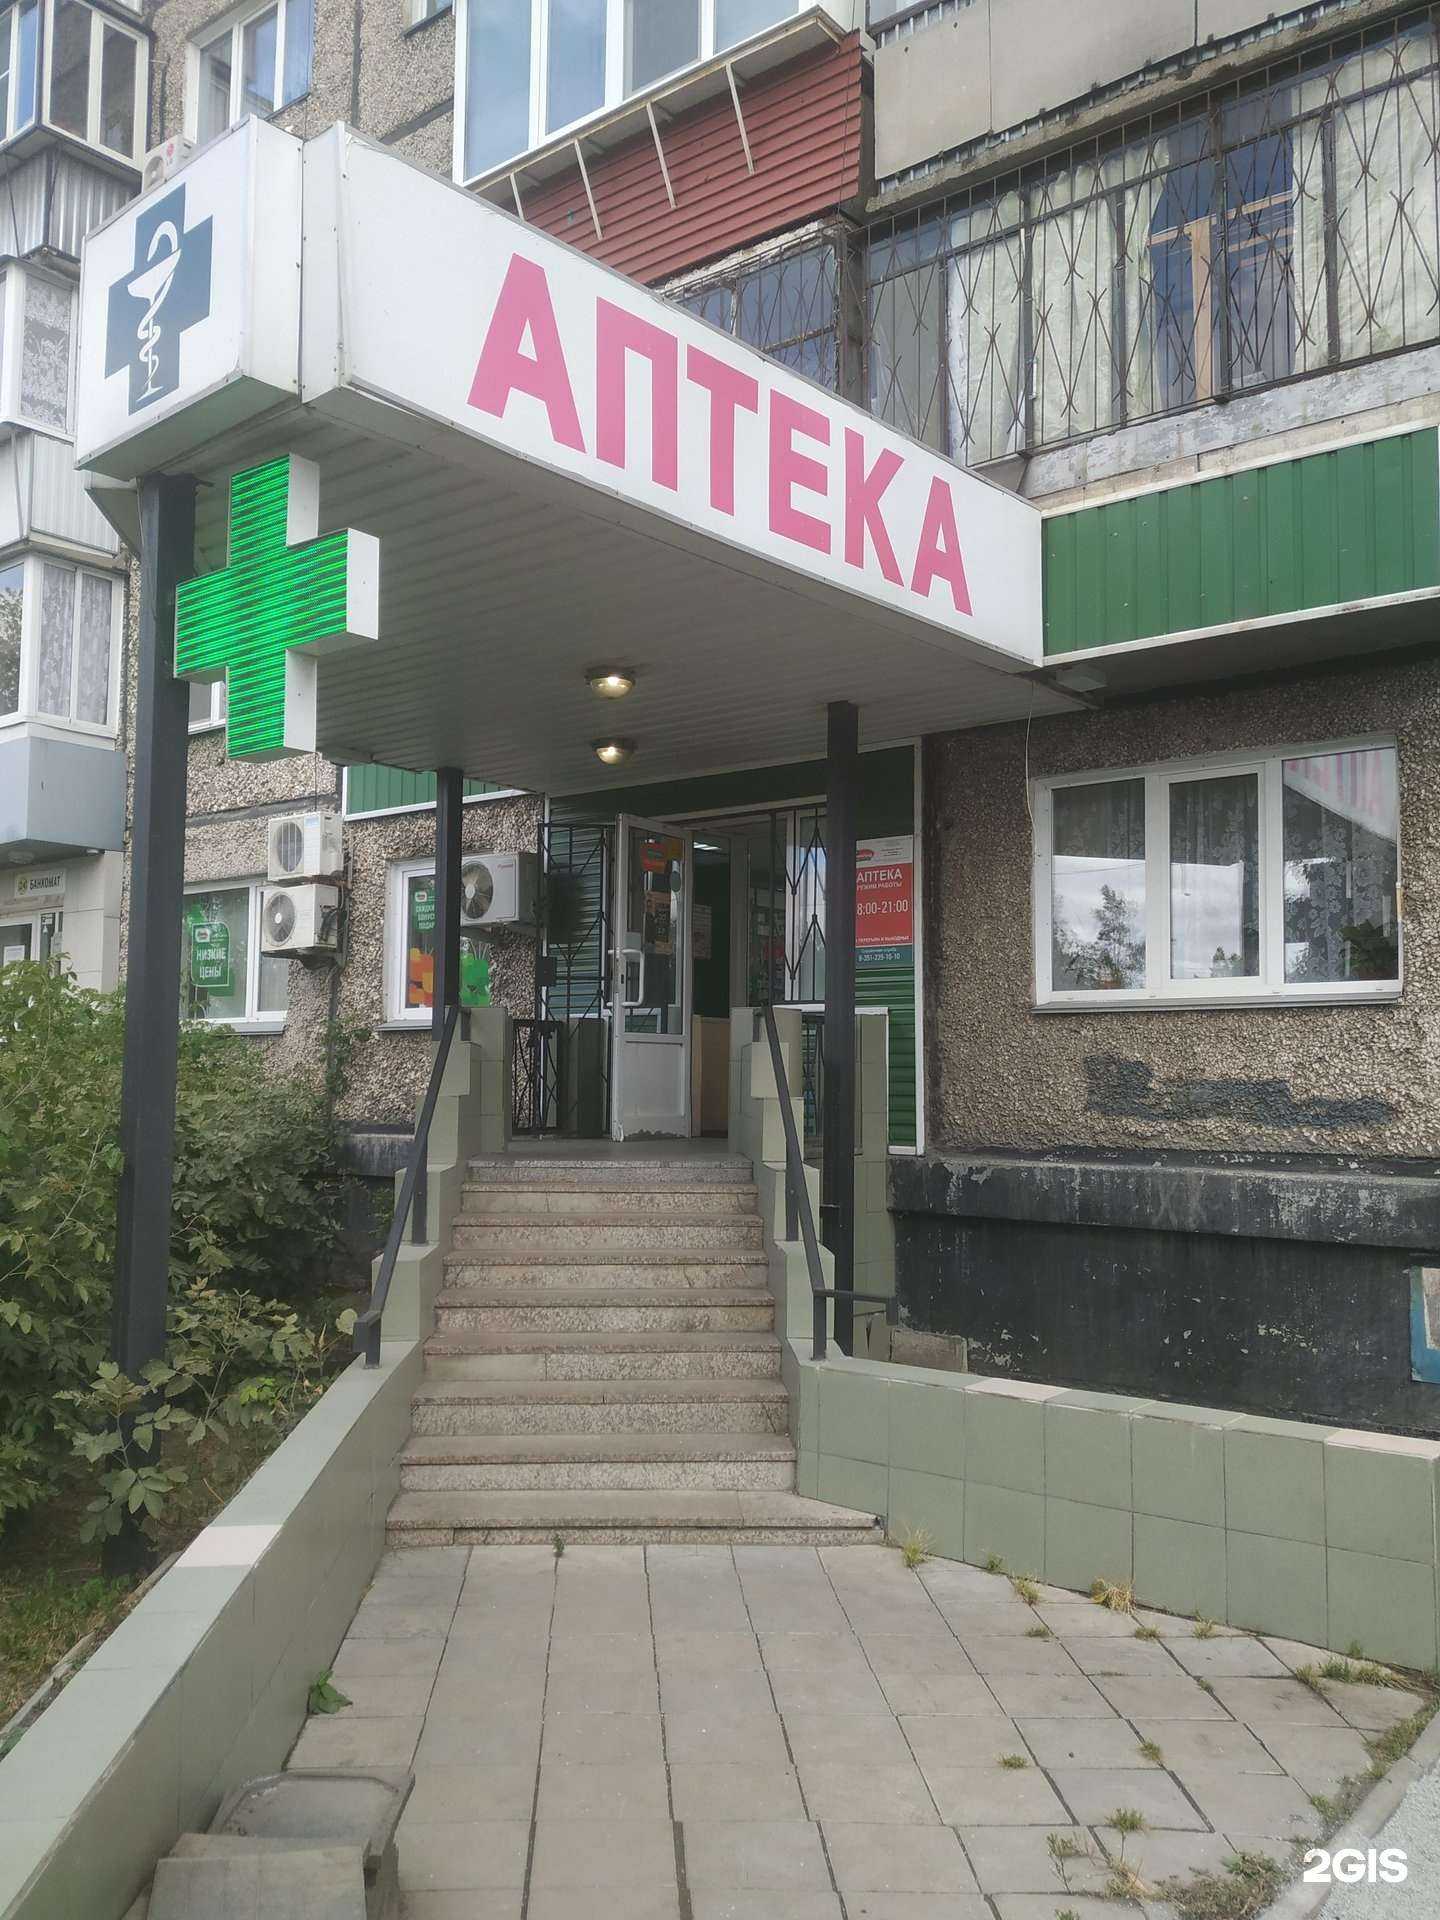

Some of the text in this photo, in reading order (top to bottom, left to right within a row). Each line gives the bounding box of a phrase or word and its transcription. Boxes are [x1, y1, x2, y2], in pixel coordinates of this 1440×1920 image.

[466, 252, 974, 617] АПТЕКА
[856, 868, 903, 883] АПТЕКА
[856, 899, 909, 916] 8:00-21:00
[196, 947, 227, 961] НИЗКИЕ
[199, 965, 222, 979] ЦЕНЫ
